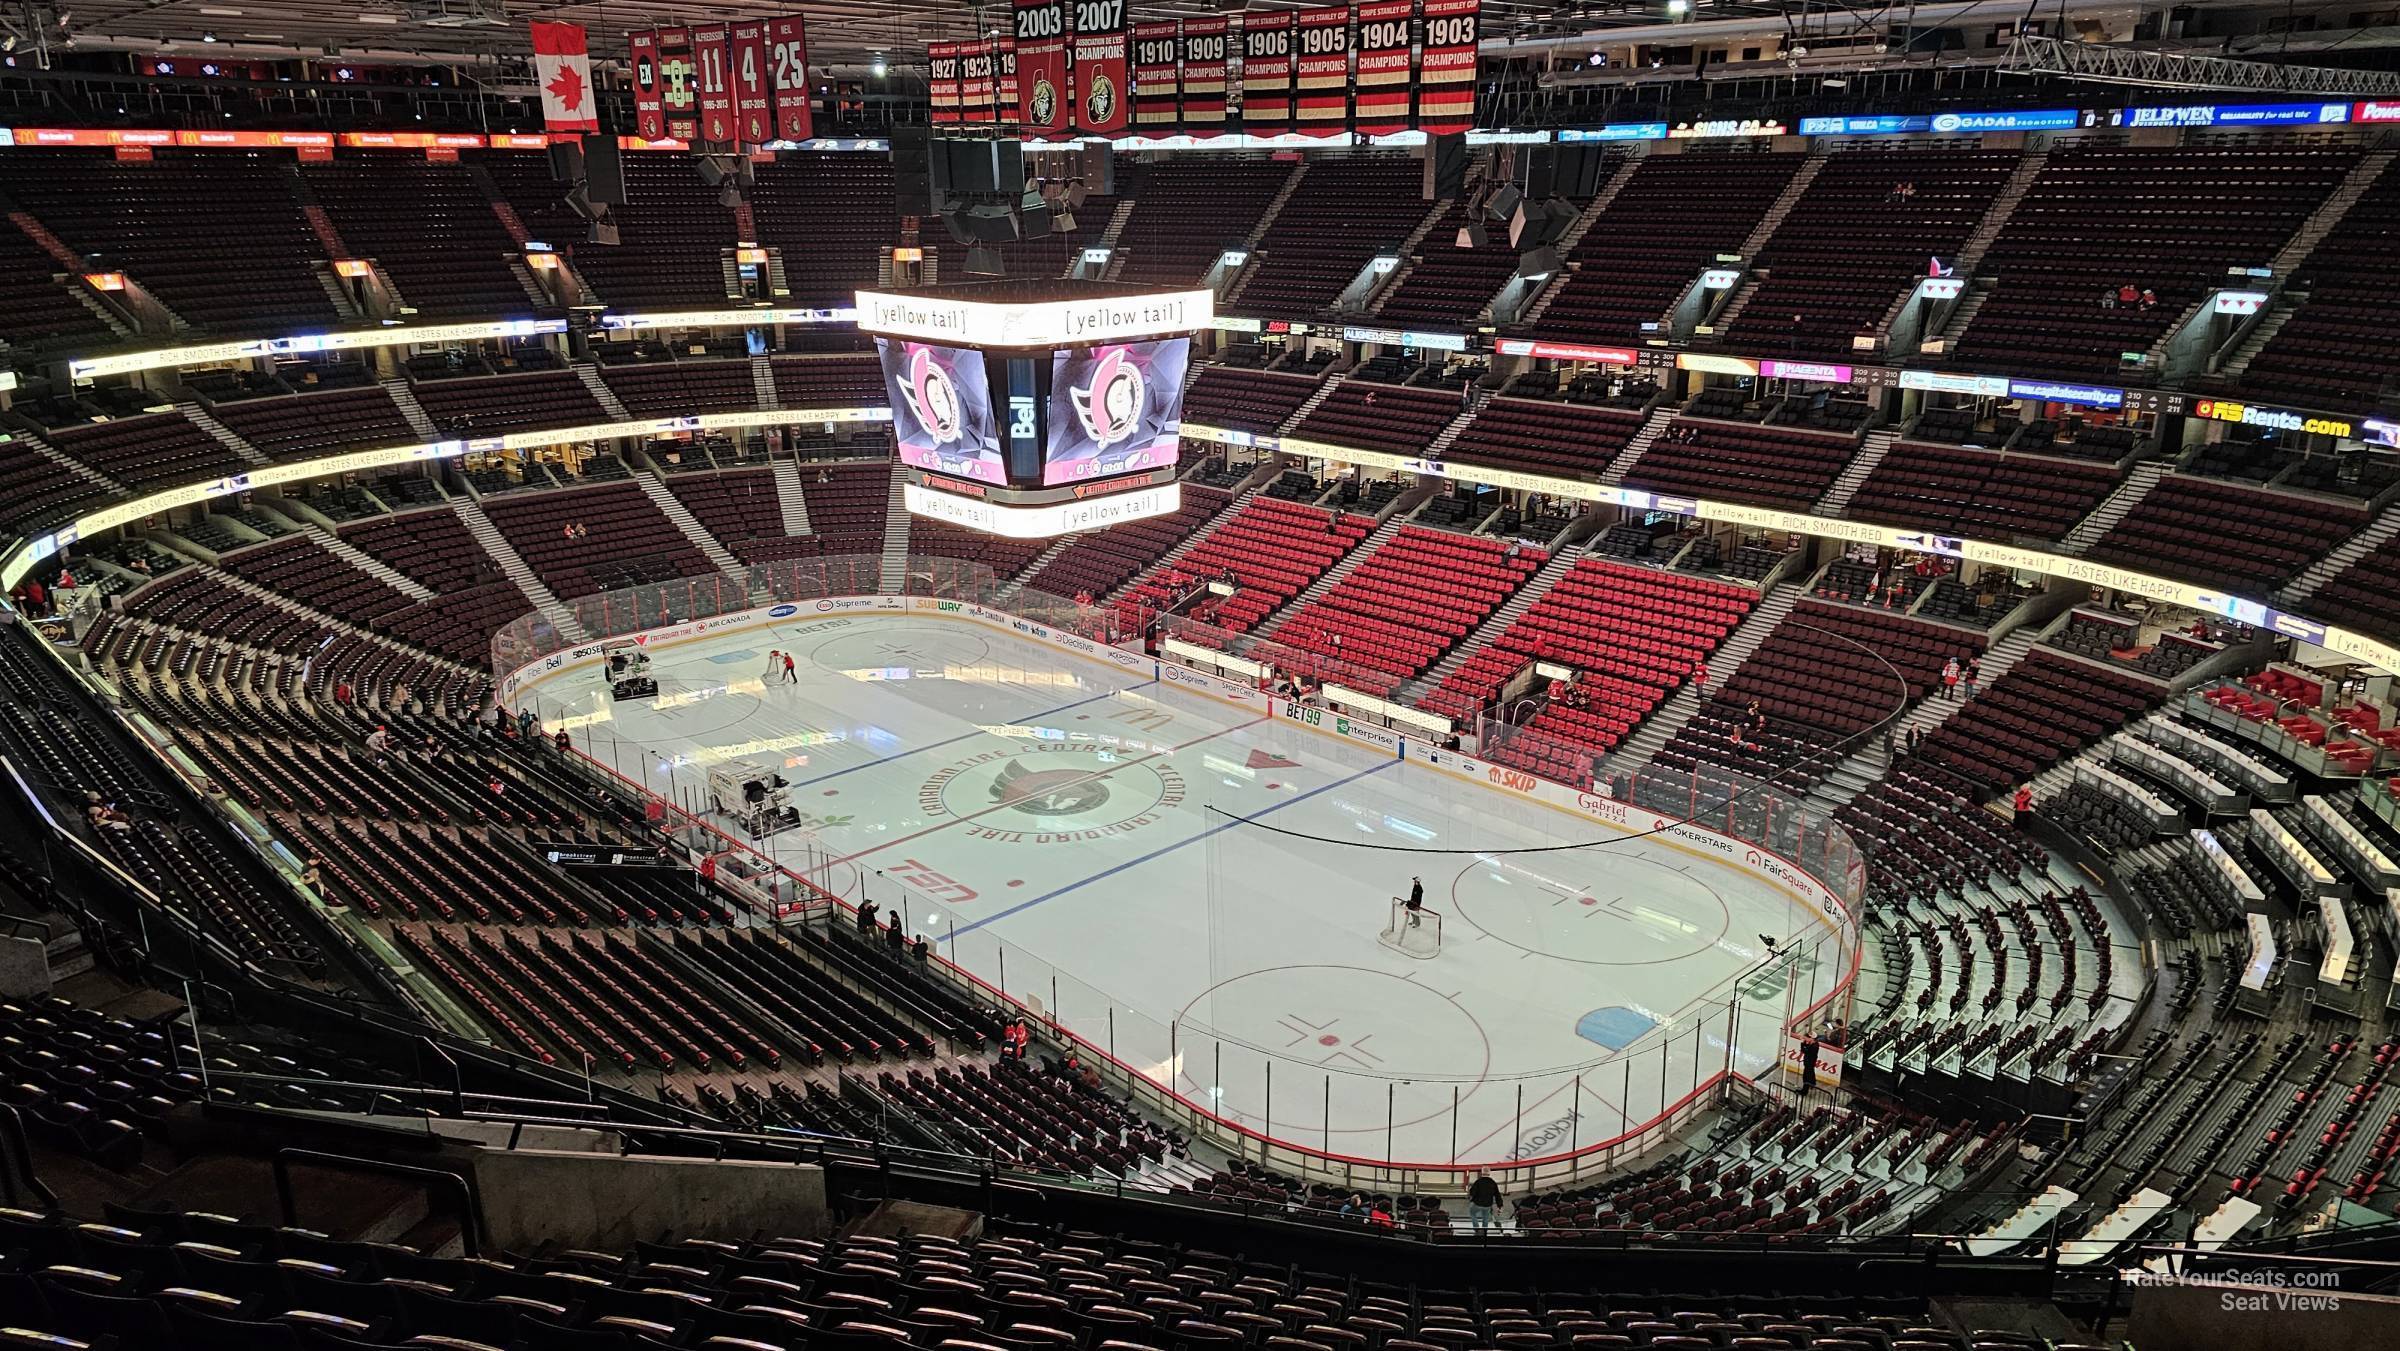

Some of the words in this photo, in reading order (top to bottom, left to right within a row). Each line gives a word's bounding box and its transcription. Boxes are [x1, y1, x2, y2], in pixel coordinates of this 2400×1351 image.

[1076, 0, 1123, 32] 2007
[1360, 7, 1377, 17] COUPE
[1377, 6, 1400, 16] STANLEY
[1400, 4, 1412, 14] CUP
[1425, 2, 1443, 12] COUPE
[1443, 0, 1466, 11] STANLEY
[1466, 0, 1478, 9] CUP
[1017, 6, 1062, 37] 2003
[1426, 16, 1475, 46] 1903
[736, 28, 758, 40] PHILLIPS
[1247, 31, 1288, 56] 1906
[1301, 27, 1346, 53] 1905
[1361, 21, 1409, 49] 1904
[1075, 45, 1125, 61] CHAMPIONS
[1138, 40, 1174, 64] 1910
[1186, 36, 1224, 60] 1909
[1423, 51, 1476, 66] CHAMPIONS
[702, 48, 723, 93] 11
[741, 46, 757, 92] 4
[774, 41, 805, 90] 25
[930, 59, 956, 79] 1927
[962, 56, 992, 78] 1923
[1184, 66, 1225, 79] CHAMPIONS
[1245, 62, 1289, 76] CHAMPIONS
[1298, 58, 1347, 73] CHAMPIONS
[1359, 54, 1410, 69] CHAMPIONS
[671, 59, 685, 108] 8
[1137, 69, 1176, 81] CHAMPIONS
[963, 81, 993, 94] CHAMPONS
[931, 309, 967, 334] tail]
[1144, 300, 1184, 325] tail]
[1268, 321, 1288, 330] ROSS
[1854, 368, 1868, 376] 309
[1883, 378, 1897, 386] 210
[2125, 400, 2140, 409] 210
[2167, 404, 2181, 414] 211
[2126, 391, 2142, 400] 310
[2168, 395, 2182, 405] 311
[1010, 395, 1035, 440] Bell
[1510, 475, 1540, 490] TASTES
[1540, 480, 1559, 492] LIKE
[1559, 482, 1589, 497] HAPPY
[1126, 493, 1159, 516] tail]
[1812, 518, 1858, 538] SMOOTH
[1860, 526, 1883, 541] RED
[2065, 562, 2110, 584] TASTES
[2110, 573, 2138, 589] LIKE
[2140, 579, 2184, 601] HAPPY
[835, 599, 872, 609] Supreme
[915, 599, 963, 613] SUBWAY
[708, 620, 720, 629] AIR
[720, 614, 751, 626] CANADA
[794, 618, 852, 635] BET99
[650, 631, 678, 643] CANADIAN
[678, 628, 693, 638] TIRE
[1062, 633, 1094, 653] Decisive
[545, 655, 563, 671] Bell
[1180, 671, 1209, 688] Supreme
[1286, 702, 1321, 727] BET99
[1339, 720, 1393, 746] enterprise
[918, 768, 959, 818] CANADIAN
[955, 749, 1009, 768] TIRE
[1021, 743, 1113, 754] CENTRE
[1158, 770, 1186, 809] CENTRE
[1503, 770, 1537, 793] SKIP
[1578, 793, 1628, 818] Gabriel
[1591, 808, 1627, 825] PIZZA
[965, 826, 1024, 844] TIRE
[1036, 812, 1163, 844] CANADIAN
[1667, 826, 1733, 853] POKERSTARS
[1763, 858, 1813, 897] FairSquare
